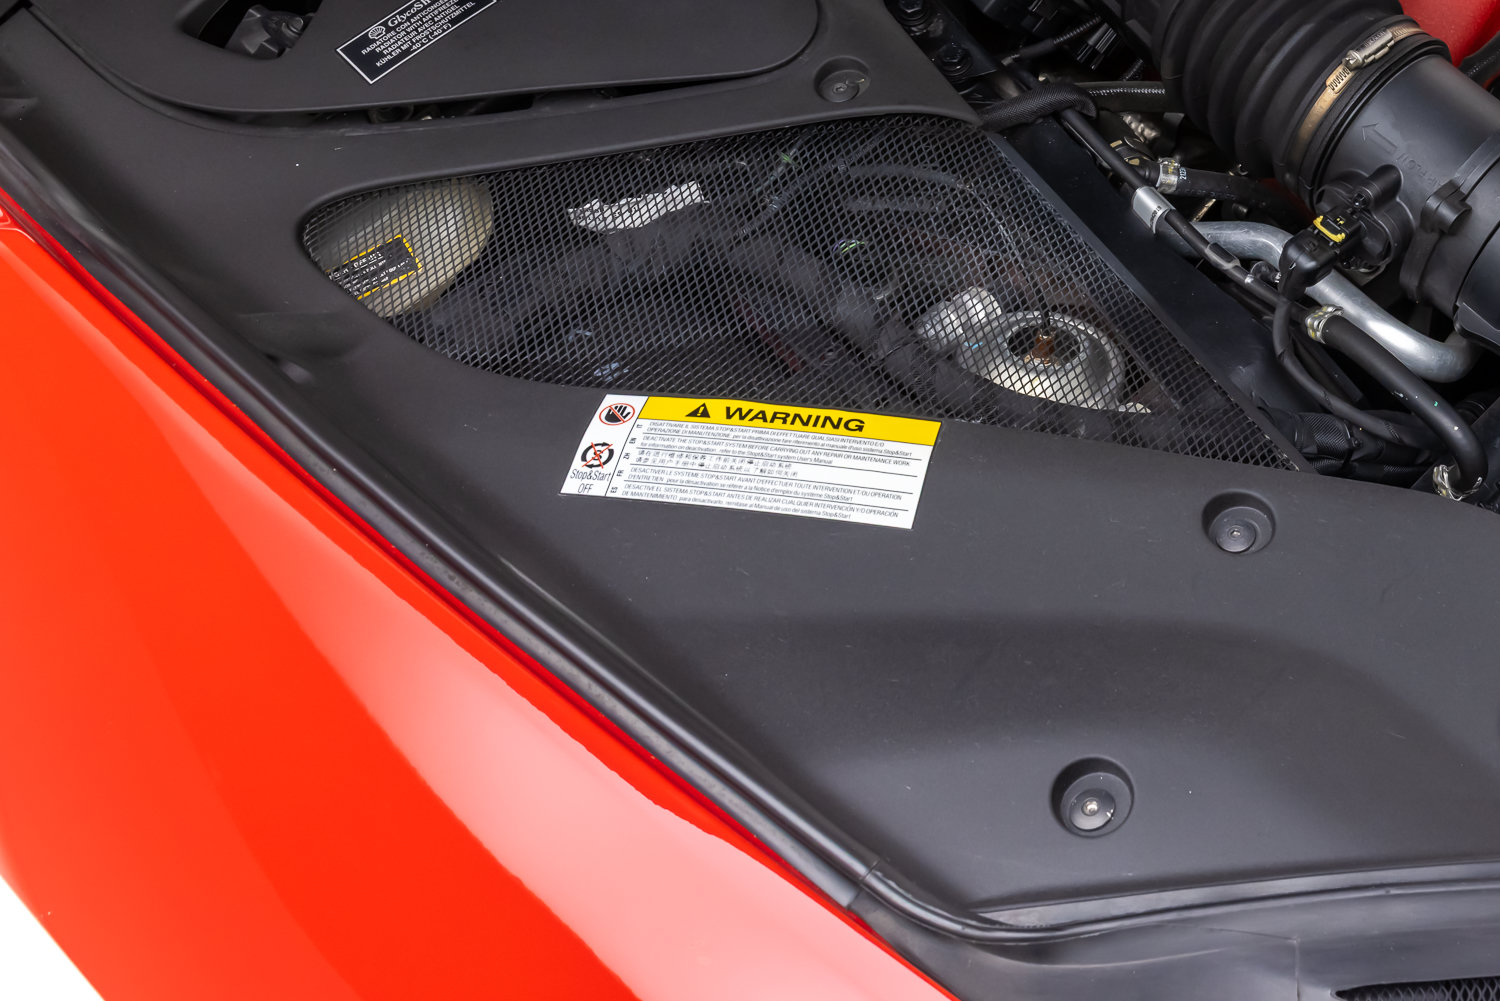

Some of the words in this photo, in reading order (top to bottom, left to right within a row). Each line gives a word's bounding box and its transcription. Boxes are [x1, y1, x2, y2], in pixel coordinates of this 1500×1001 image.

[362, 31, 396, 54] RADIATORE
[396, 22, 410, 32] CON
[375, 31, 407, 52] RADIATOR
[406, 21, 422, 32] WITH
[376, 49, 401, 66] KÜHLER
[401, 41, 413, 50] MIT
[412, 1, 475, 42] FROSTSCHUTZMITTEL
[383, 31, 417, 54] RADIATEUR
[417, 20, 434, 32] AVEC
[434, 4, 459, 21] ANTIGEL
[725, 405, 865, 433] WARNING
[570, 469, 612, 482] Stop&Start
[577, 483, 594, 494] OFF
